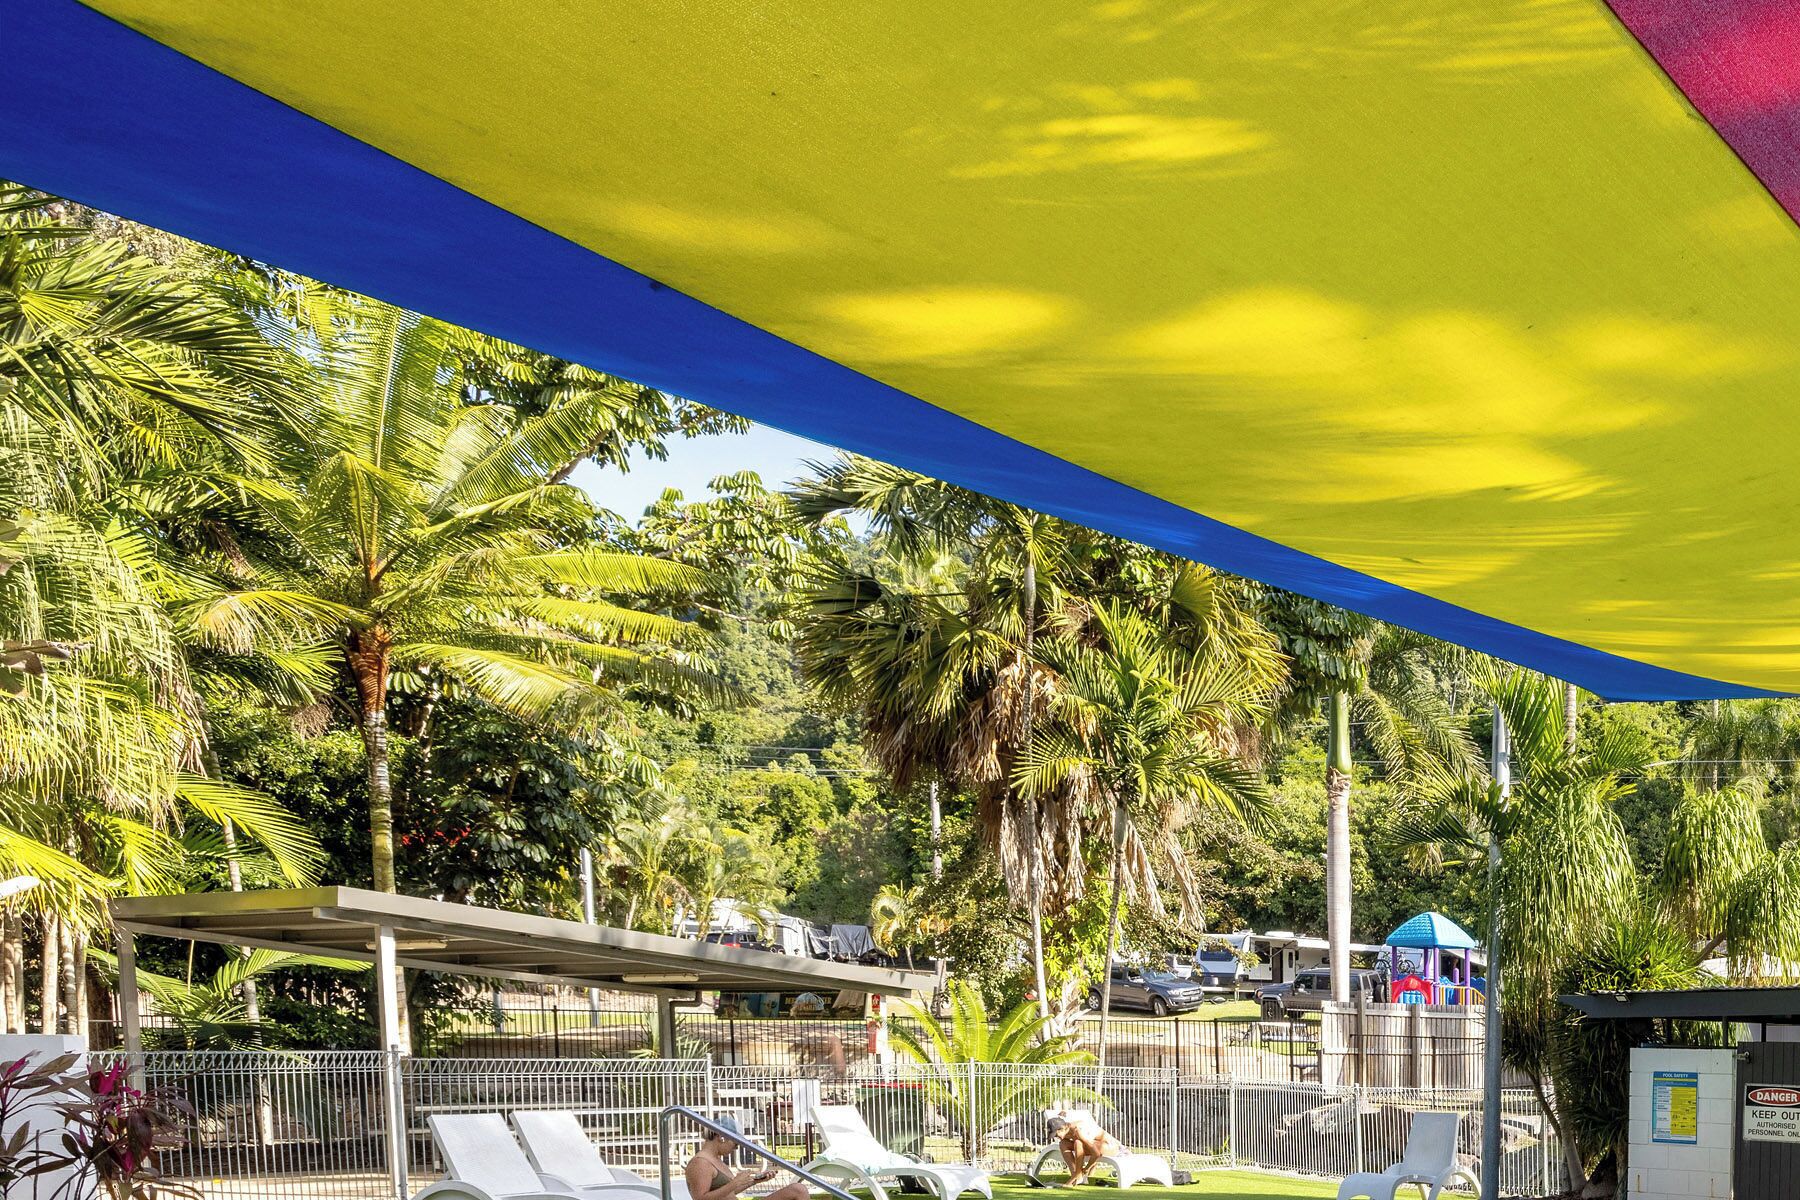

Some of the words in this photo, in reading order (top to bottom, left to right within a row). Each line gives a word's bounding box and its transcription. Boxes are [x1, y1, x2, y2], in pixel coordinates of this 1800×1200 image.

[1757, 1092, 1797, 1102] DANGER
[1752, 1110, 1776, 1119] KEEP
[1781, 1111, 1800, 1120] OUT
[1757, 1121, 1796, 1129] AUTHORISED
